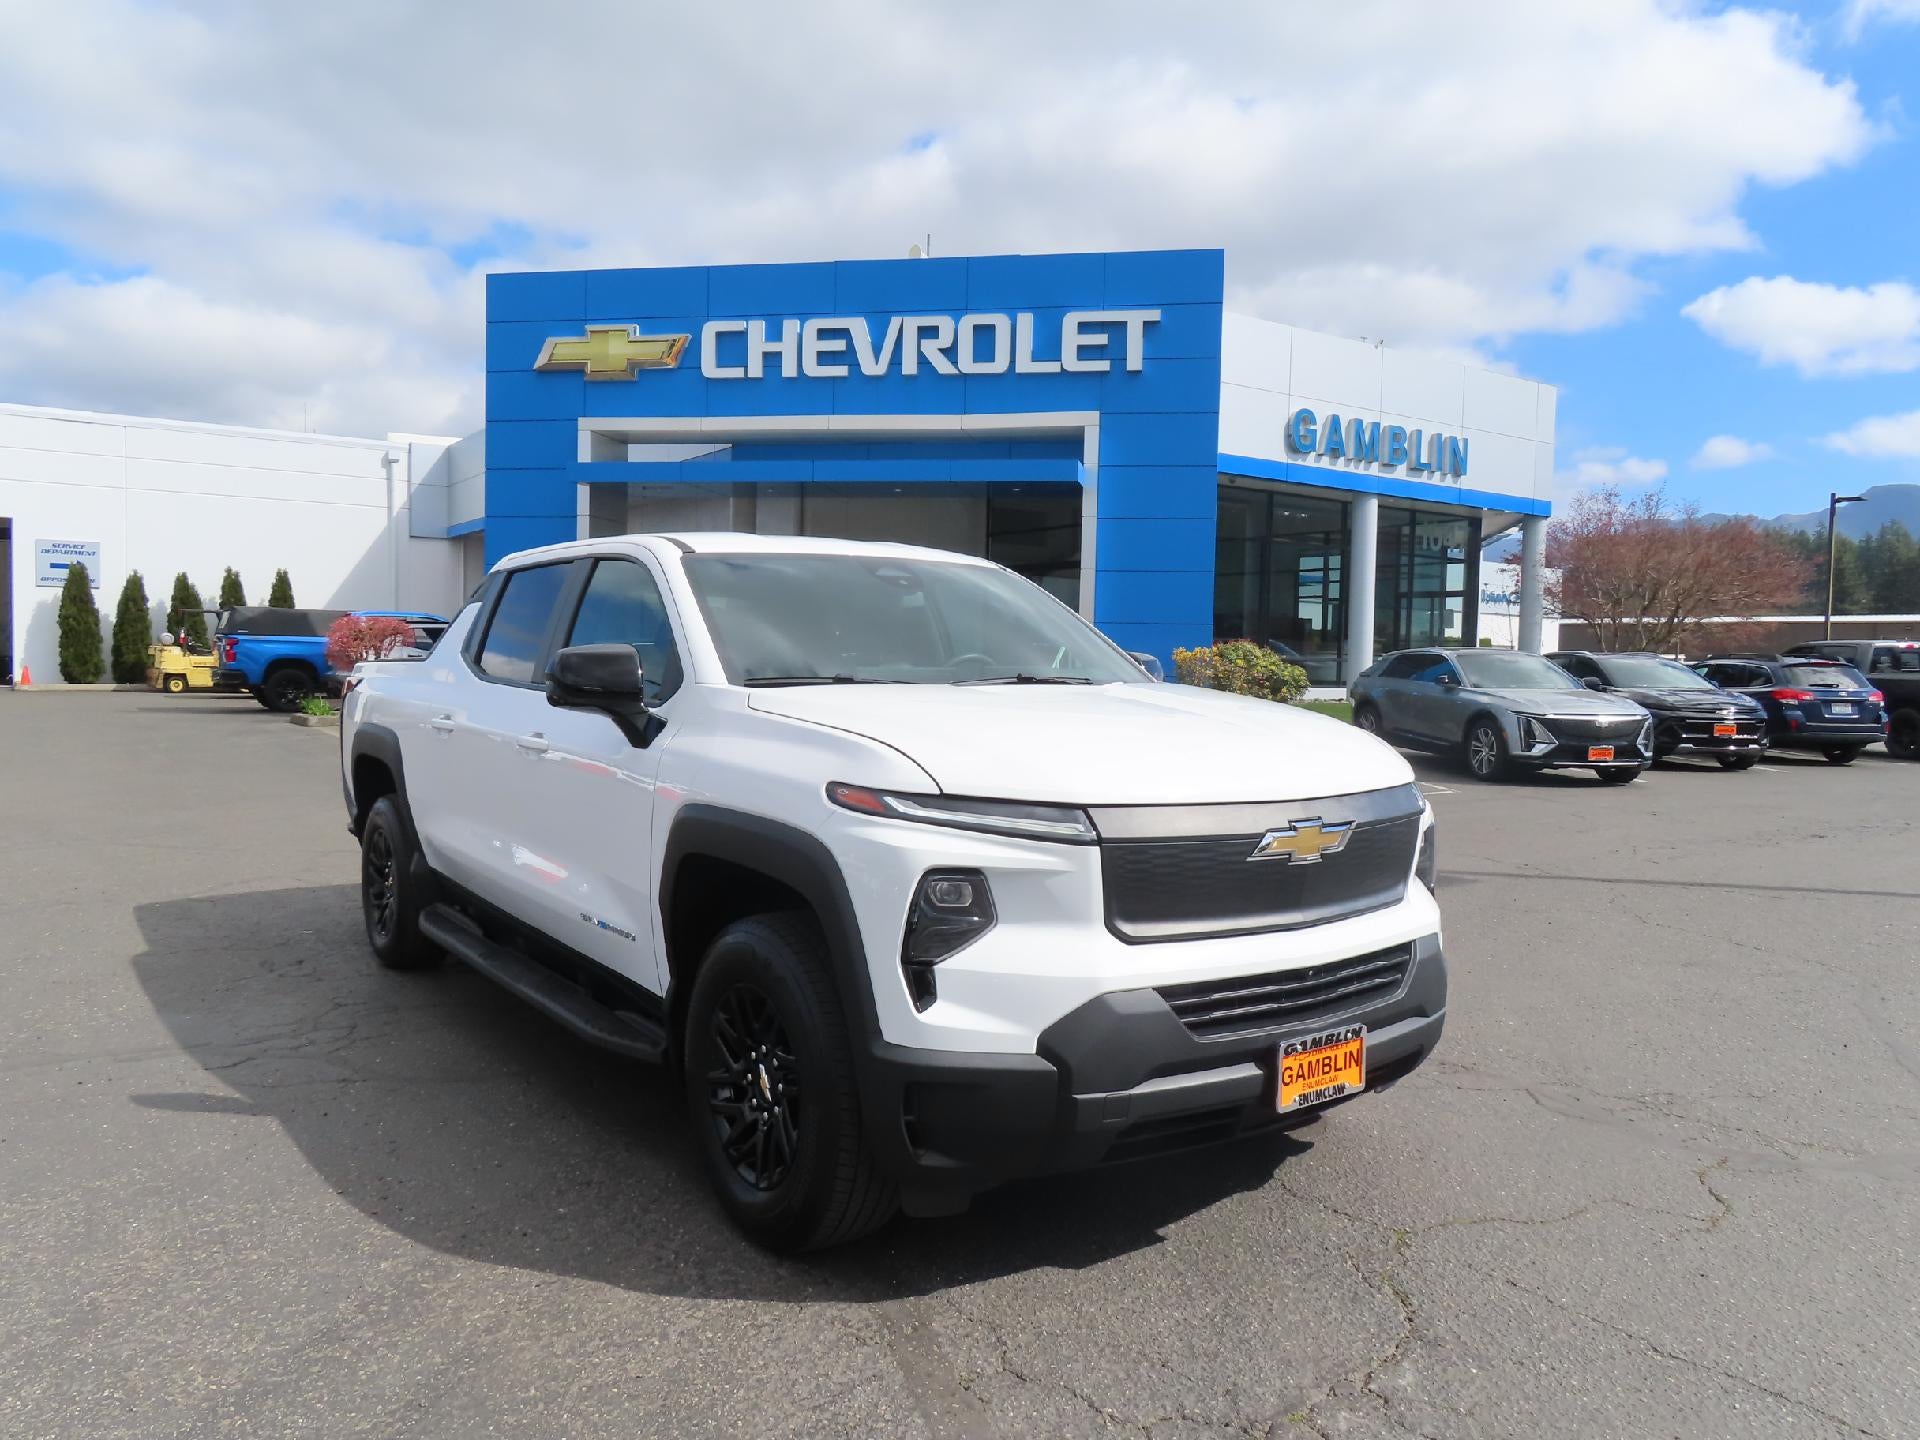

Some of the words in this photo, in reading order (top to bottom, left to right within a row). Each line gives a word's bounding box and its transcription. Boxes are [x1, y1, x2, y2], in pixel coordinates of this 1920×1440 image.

[701, 309, 1162, 379] CHEVROLET
[1287, 408, 1468, 476] GAMBLIN
[40, 548, 96, 556] DEPARTMENT
[1284, 1026, 1363, 1056] GAMBLIN
[1281, 1048, 1360, 1087] GAMBLIN
[1298, 1083, 1346, 1107] ENUMCLAW
